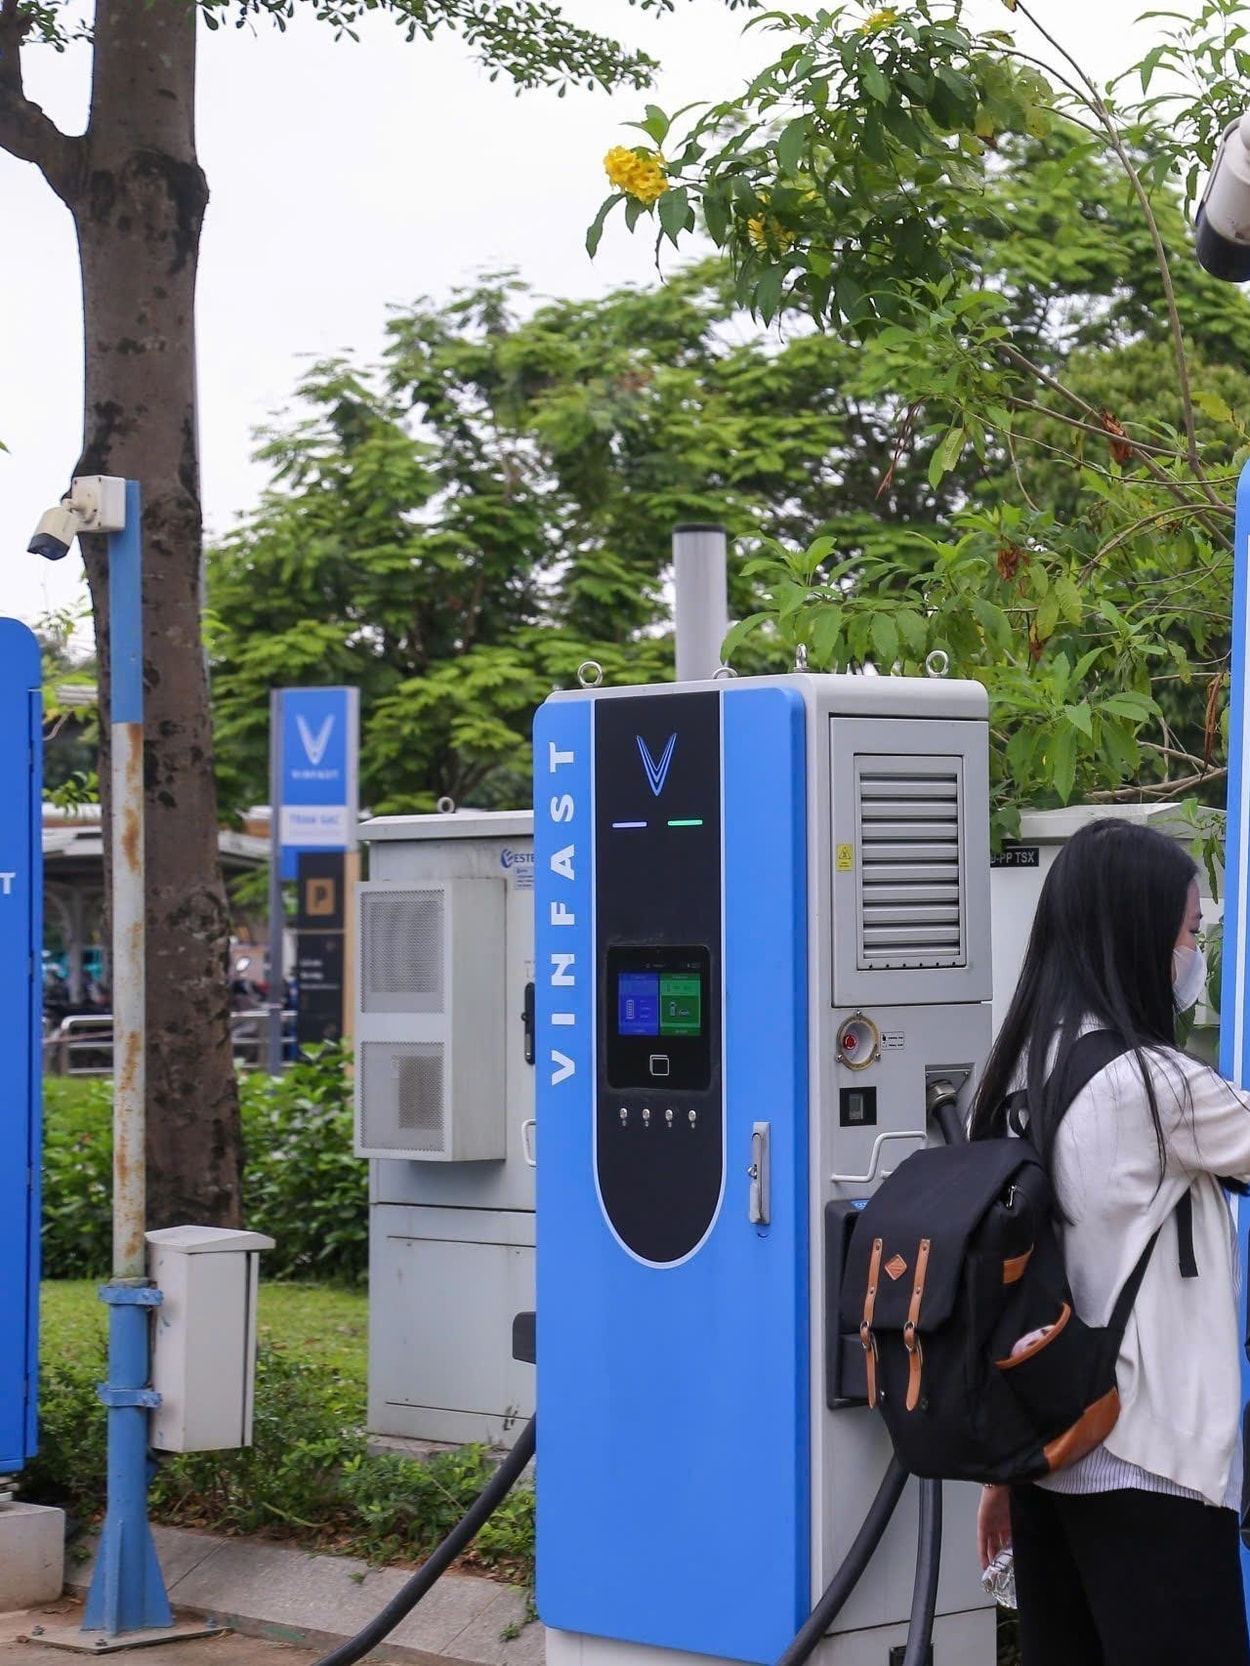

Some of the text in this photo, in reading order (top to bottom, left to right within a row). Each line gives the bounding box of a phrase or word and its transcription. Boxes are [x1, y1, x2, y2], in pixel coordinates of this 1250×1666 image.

[1015, 851, 1034, 863] TSX
[314, 885, 327, 909] P
[549, 741, 575, 1086] VINFAST
